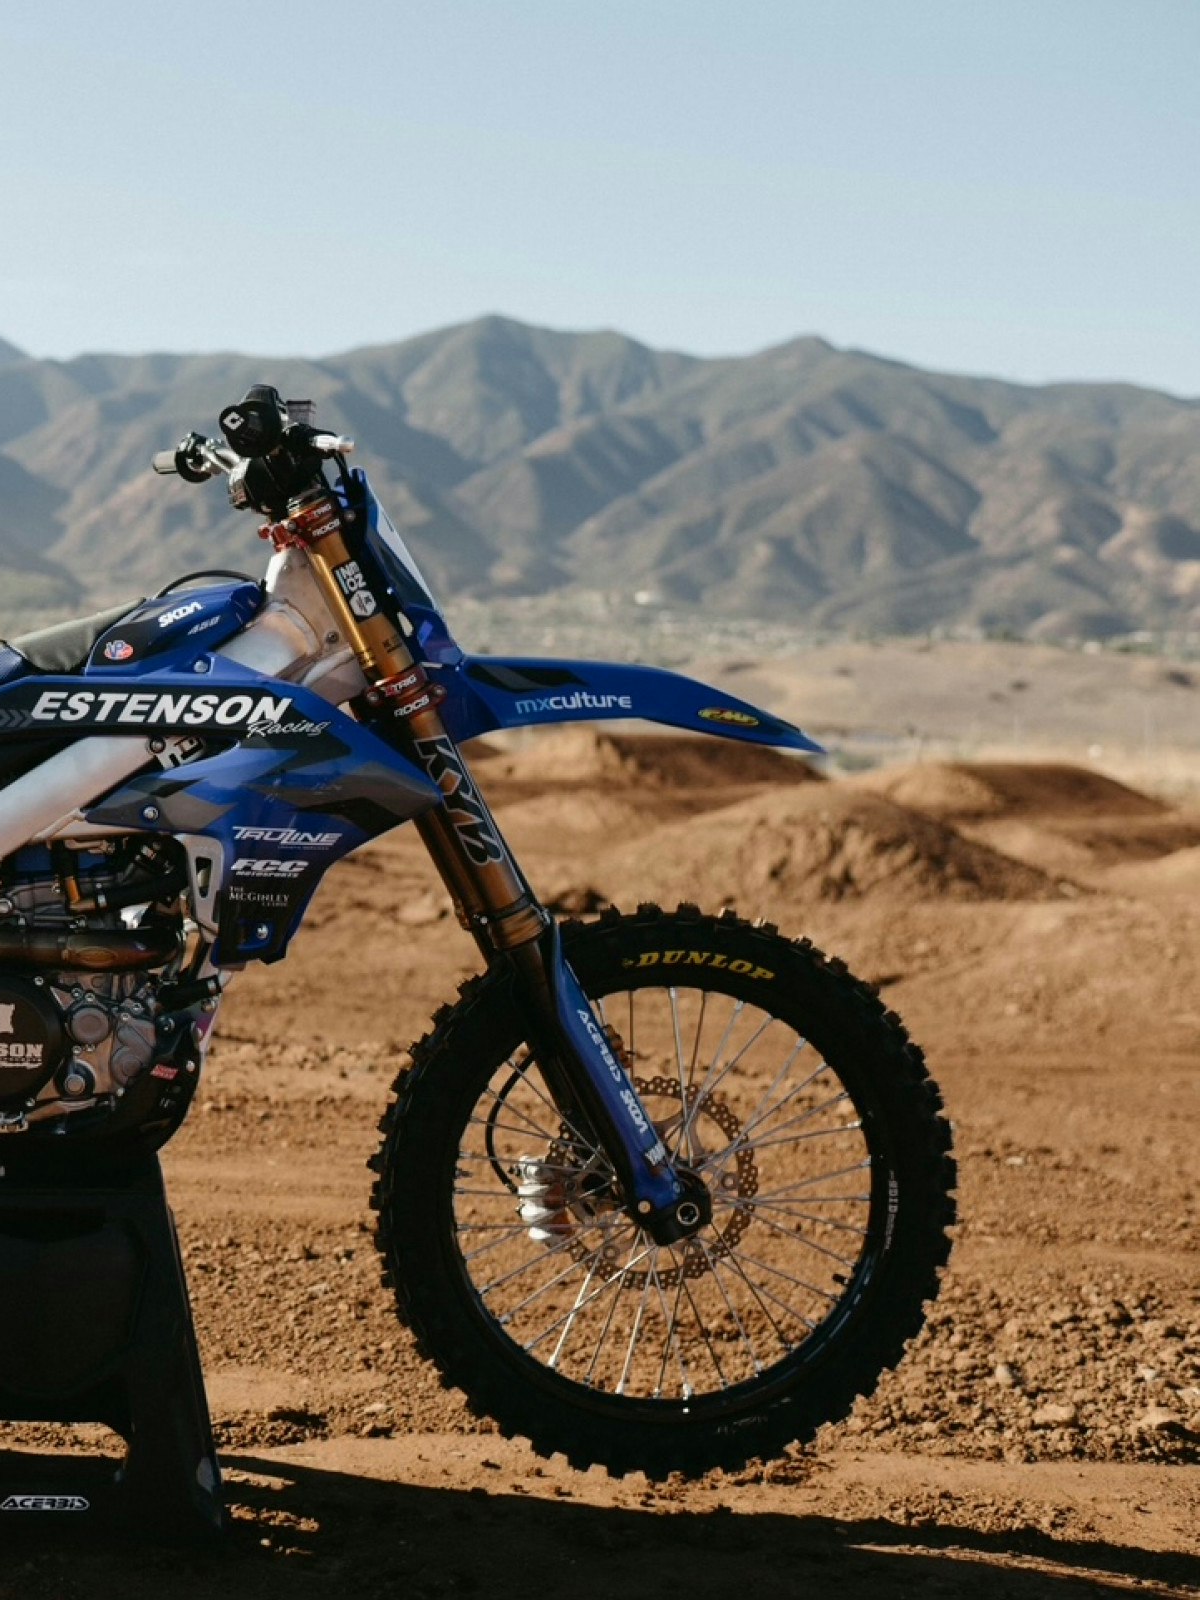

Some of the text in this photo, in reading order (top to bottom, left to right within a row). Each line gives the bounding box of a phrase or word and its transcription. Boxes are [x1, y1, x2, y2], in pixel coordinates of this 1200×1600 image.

[30, 691, 292, 725] ESTENSON
[514, 692, 633, 714] mxculture
[246, 719, 332, 739] Racing
[230, 859, 310, 872] FCC
[636, 950, 775, 981] DUNLOP
[2, 1497, 89, 1510] ACERBIS
